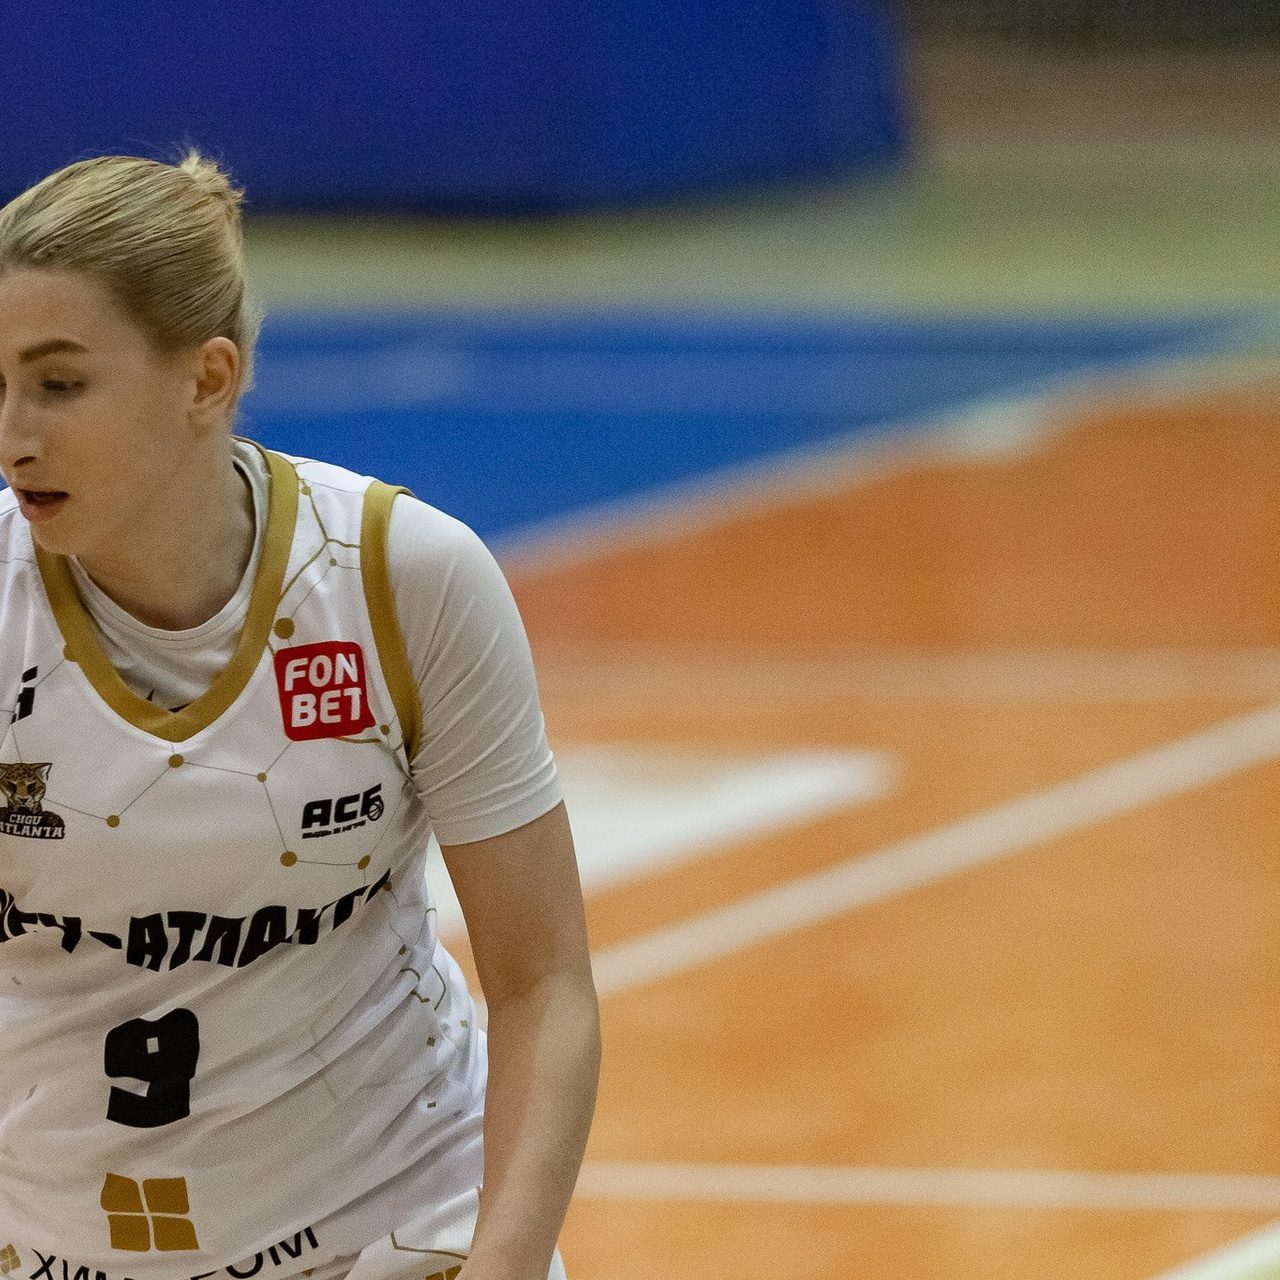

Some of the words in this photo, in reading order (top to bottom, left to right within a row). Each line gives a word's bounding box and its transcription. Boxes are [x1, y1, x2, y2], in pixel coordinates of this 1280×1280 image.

[284, 652, 359, 692] FON
[291, 686, 362, 728] BET
[9, 813, 43, 825] CHGU
[104, 1007, 201, 1128] 9
